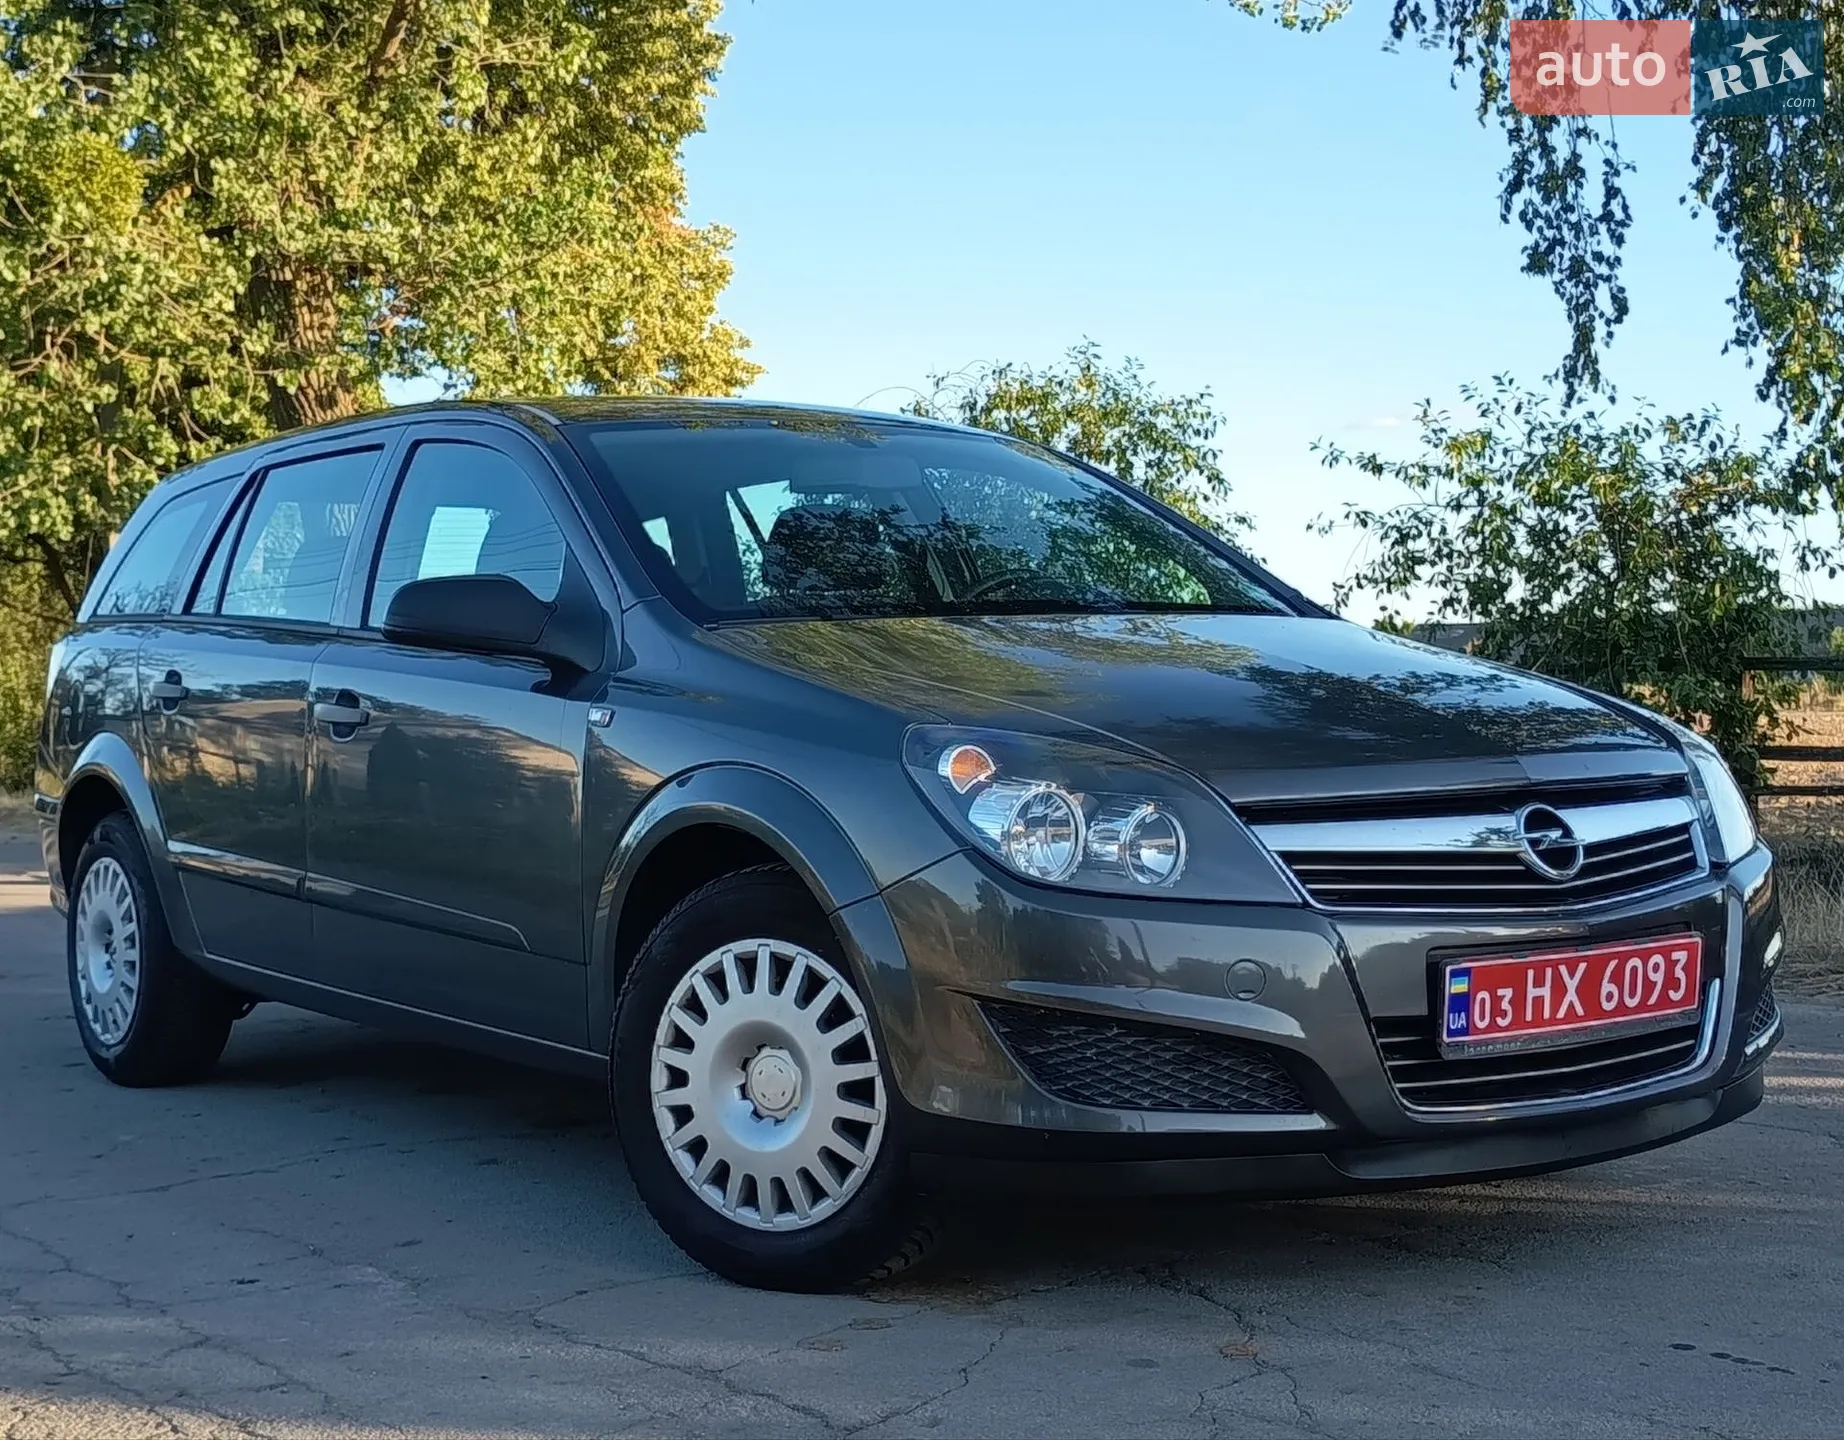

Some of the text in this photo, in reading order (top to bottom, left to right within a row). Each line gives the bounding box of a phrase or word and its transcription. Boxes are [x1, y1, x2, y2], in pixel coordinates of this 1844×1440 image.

[1473, 950, 1688, 1029] 03 HX 6093
[1449, 1011, 1467, 1029] UA
